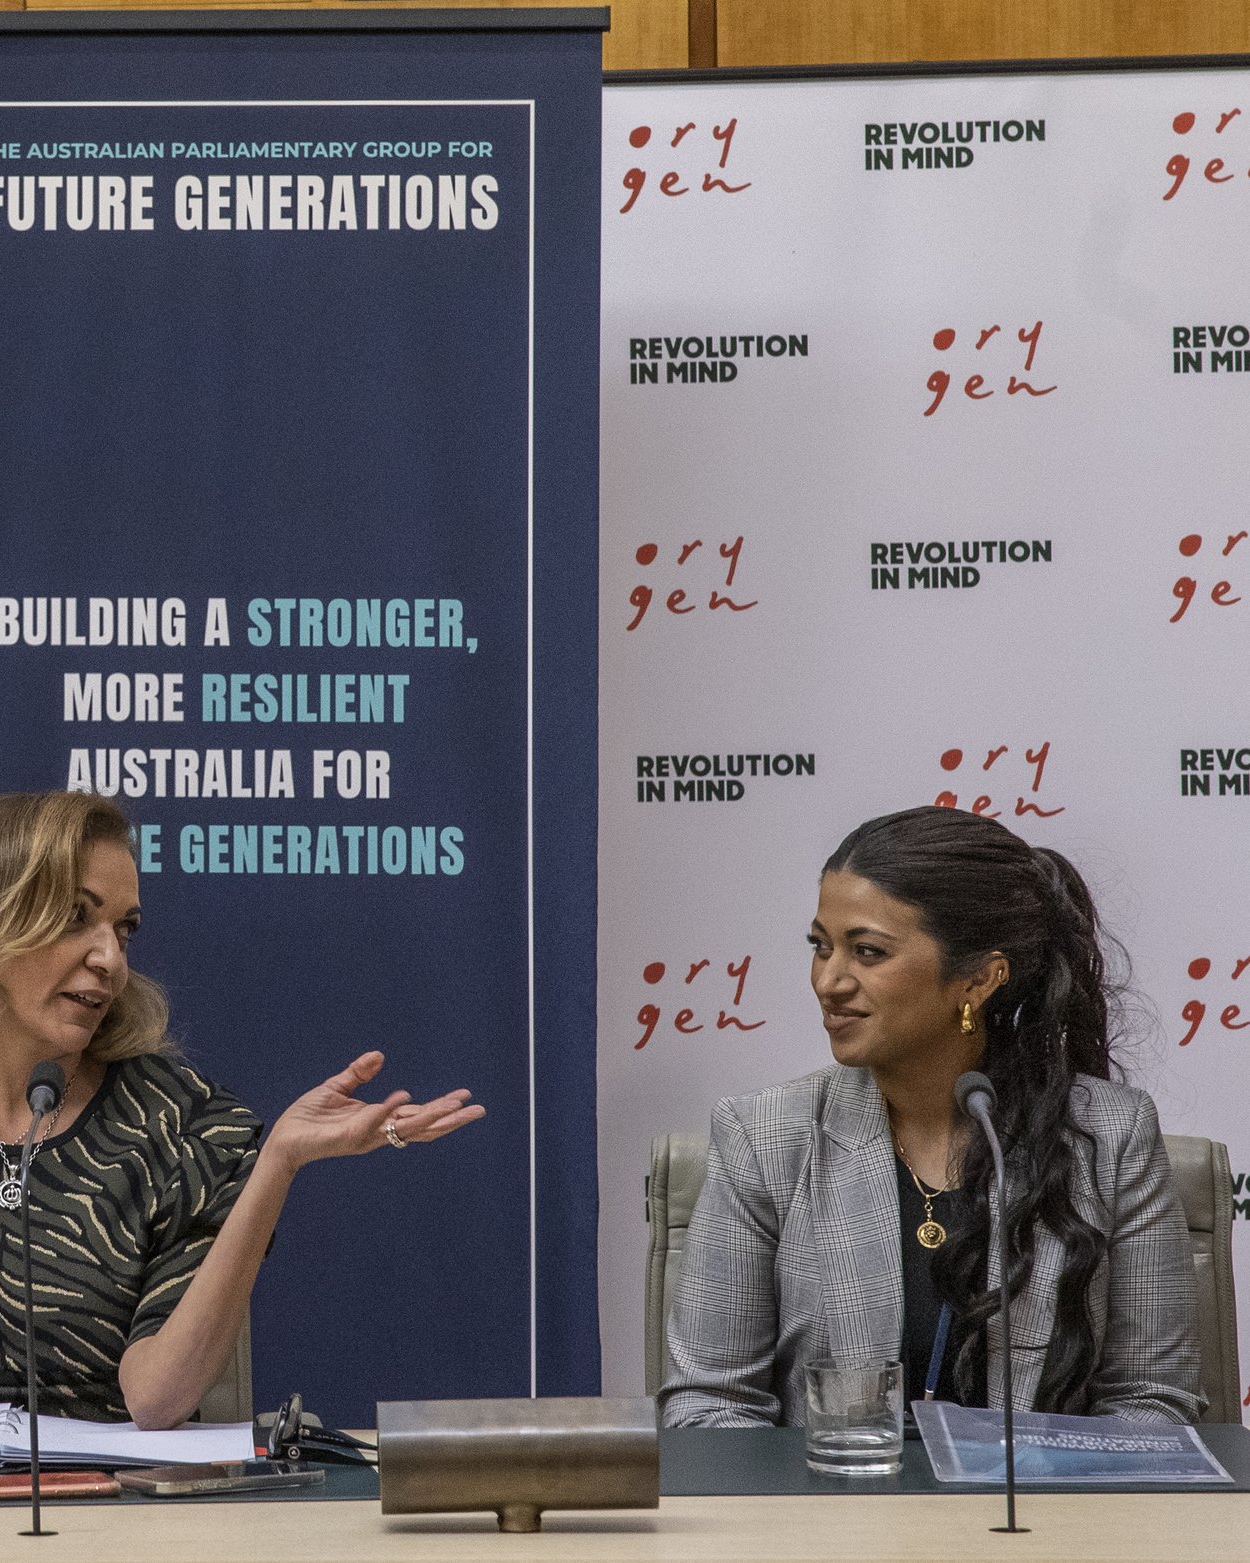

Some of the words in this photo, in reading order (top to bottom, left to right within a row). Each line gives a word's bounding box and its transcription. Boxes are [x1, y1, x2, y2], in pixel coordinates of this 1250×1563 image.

[26, 142, 165, 159] AUSTRALIAN
[171, 141, 358, 159] PARLIAMENTARY
[362, 141, 442, 158] GROUP
[448, 141, 493, 158] FOR
[629, 118, 737, 168] ory
[864, 119, 1046, 146] REVOLUTION
[865, 148, 898, 171] IN
[902, 147, 974, 170] MIND
[174, 174, 499, 231] GENERATIONS
[620, 167, 751, 214] gen
[629, 334, 809, 361] REVOLUTION
[933, 320, 1043, 371] ory
[1173, 351, 1203, 374] IN
[630, 361, 659, 385] IN
[666, 360, 738, 384] MIND
[924, 369, 1057, 417] gen
[636, 536, 743, 585] ory
[870, 539, 1052, 565] REVOLUTION
[871, 567, 900, 590] IN
[908, 566, 981, 590] MIND
[203, 597, 231, 647] A
[247, 597, 478, 654] STRONGER,
[627, 584, 758, 632] gen
[63, 672, 185, 722] MORE
[202, 673, 410, 723] RESILIENT
[67, 748, 295, 798] AUSTRALIA
[312, 749, 391, 799] FOR
[636, 753, 816, 779] REVOLUTION
[940, 741, 1050, 793] ory
[1181, 774, 1211, 797] IN
[637, 779, 668, 803] IN
[674, 779, 745, 803] MIND
[179, 824, 465, 876] GENERATIONS
[642, 955, 751, 1006] ory
[634, 1004, 766, 1051] gen
